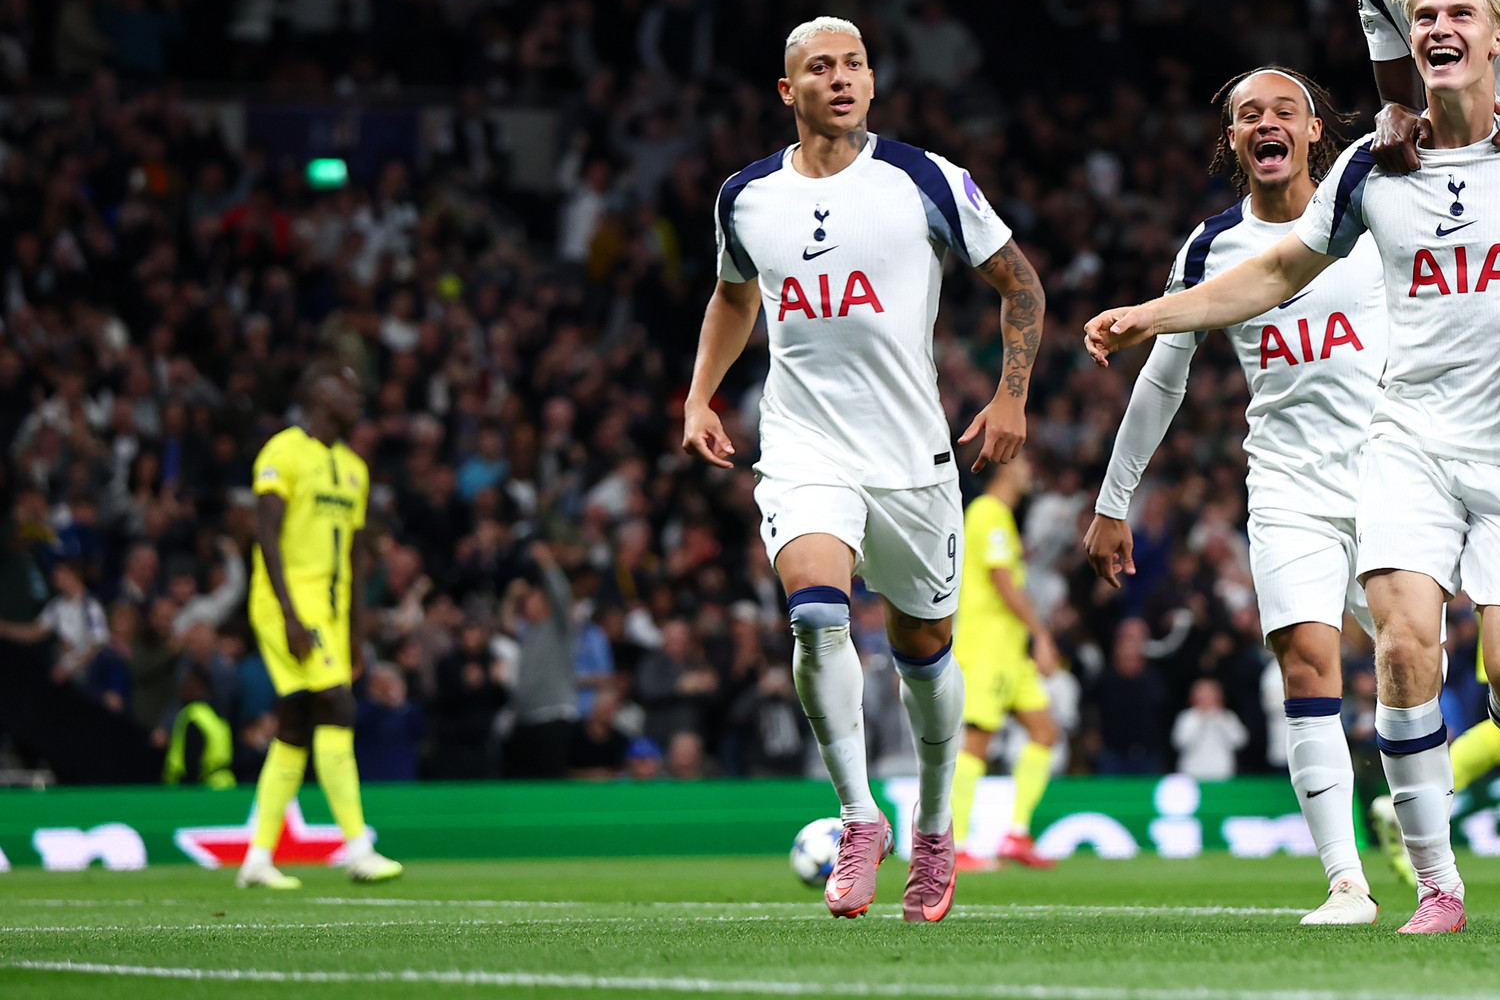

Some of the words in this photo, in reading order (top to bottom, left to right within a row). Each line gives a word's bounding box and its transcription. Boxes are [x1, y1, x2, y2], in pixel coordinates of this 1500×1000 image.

[777, 270, 885, 322] AIA
[1259, 311, 1365, 370] AIA
[945, 532, 957, 583] 9
